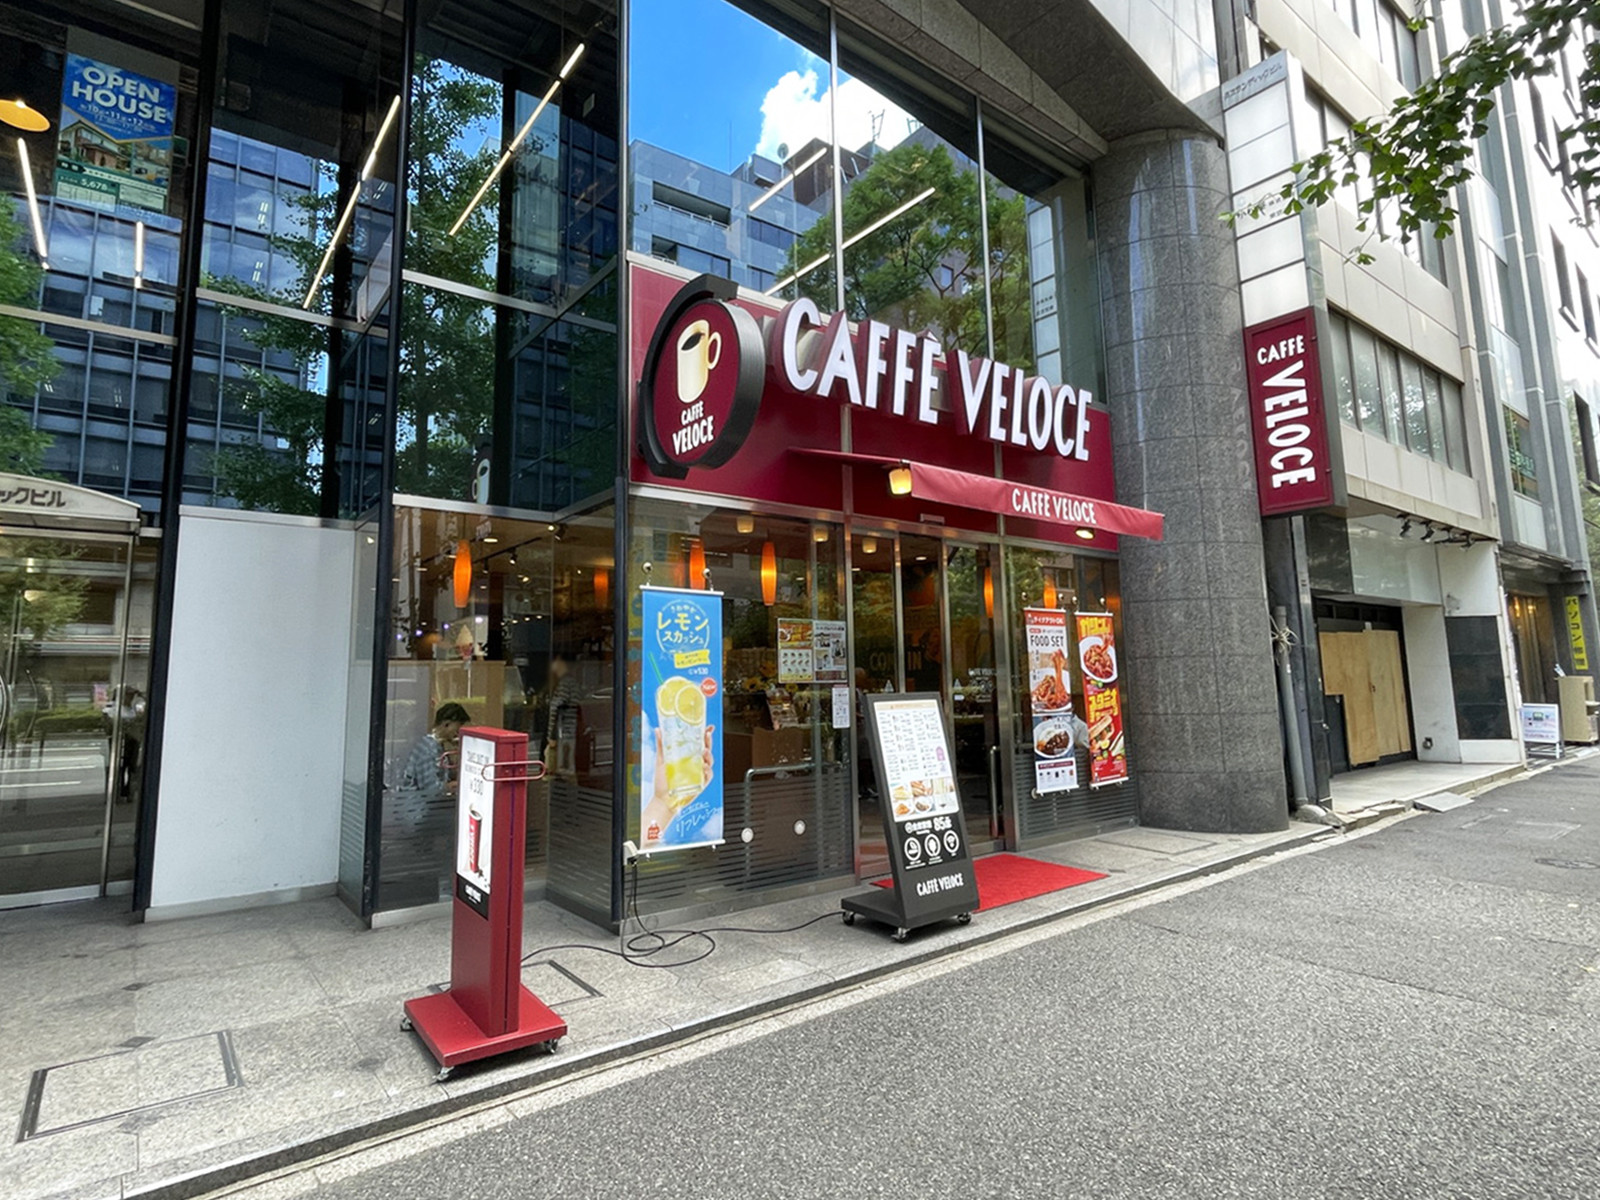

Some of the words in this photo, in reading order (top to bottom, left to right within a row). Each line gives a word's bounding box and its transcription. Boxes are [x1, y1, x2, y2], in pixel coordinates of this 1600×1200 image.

[82, 66, 160, 103] OPEN
[72, 80, 167, 124] HOUSE
[957, 349, 1093, 461] VELOCE
[672, 416, 714, 455] VELOCE
[1262, 360, 1316, 488] VELOCE
[1052, 495, 1097, 524] VELOCE
[657, 611, 709, 632] レモン
[662, 630, 704, 644] スカッシュ
[1030, 635, 1050, 647] FOOD
[1051, 636, 1065, 648] SET
[938, 872, 965, 891] VELOCE
